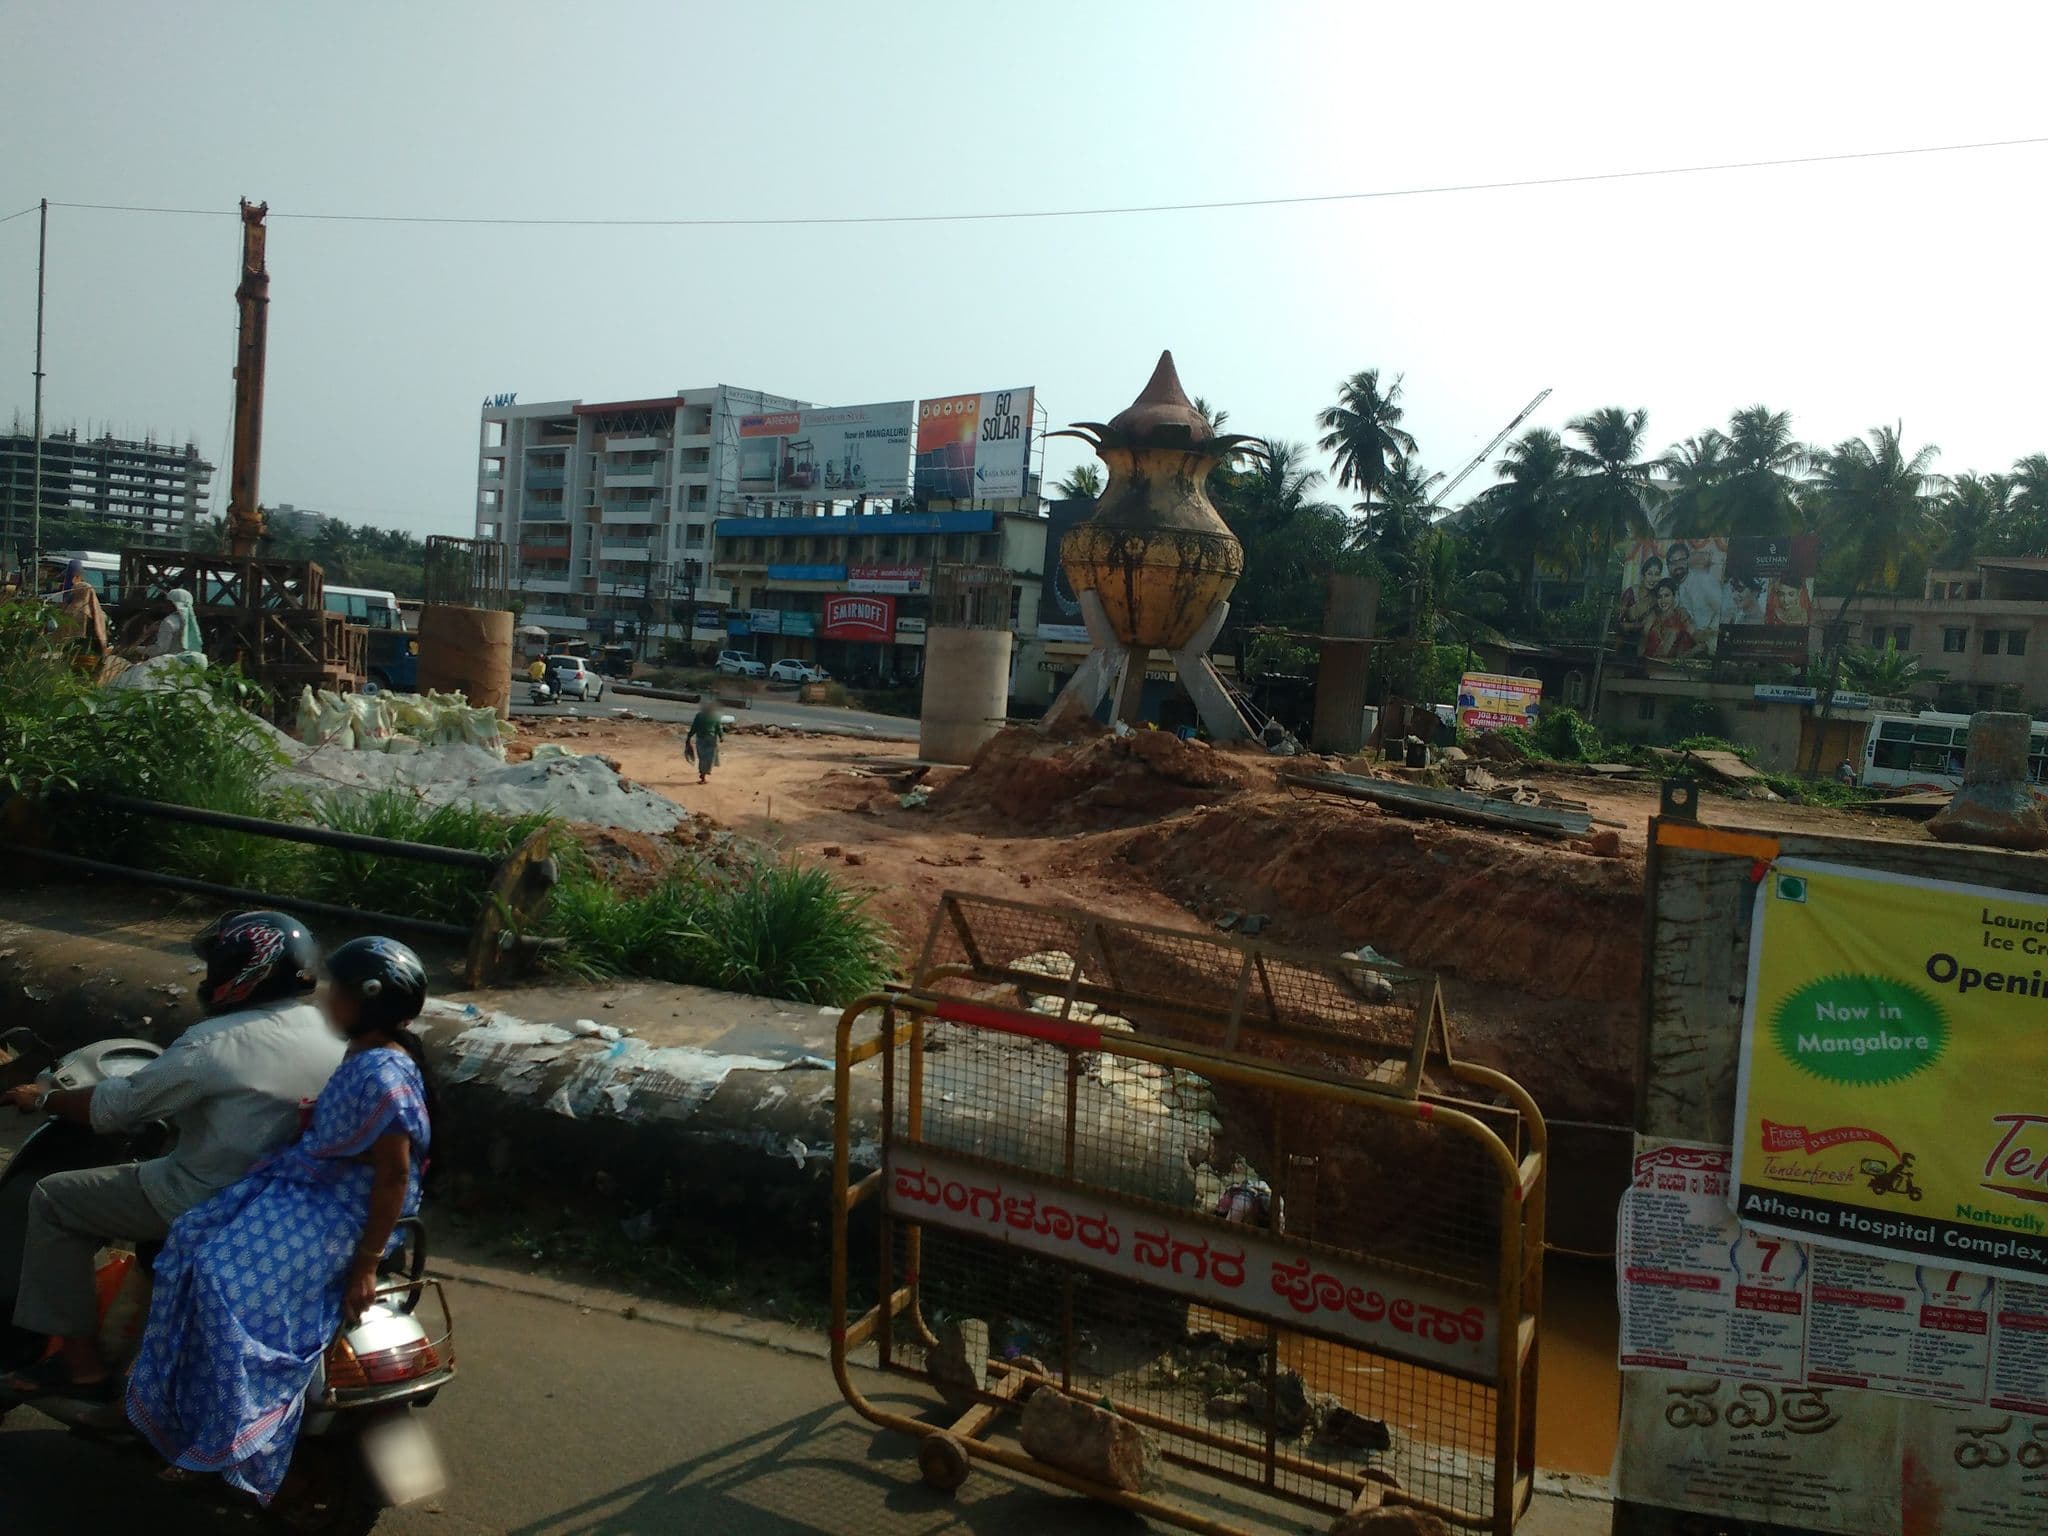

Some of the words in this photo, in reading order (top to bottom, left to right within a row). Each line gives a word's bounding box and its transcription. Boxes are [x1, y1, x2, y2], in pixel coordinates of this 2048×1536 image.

[495, 393, 517, 407] MAK
[995, 392, 1012, 417] GO
[764, 414, 798, 426] ARENA
[982, 415, 1020, 442] SOLAR
[844, 432, 858, 440] Now
[866, 428, 909, 439] MANGALURU
[832, 602, 883, 623] SMIRNOFF
[1982, 908, 2048, 934] Launc
[1984, 931, 2014, 950] Ice
[2023, 937, 2048, 955] Cr
[1815, 1002, 1869, 1021] Now
[1880, 1003, 1902, 1021] in
[1798, 1031, 1929, 1055] Mangalore
[1769, 1127, 1802, 1139] Free
[1771, 1136, 1806, 1147] Home
[1810, 1131, 1871, 1148] DELIVERY
[1763, 1156, 1855, 1184] Tenderfresh
[894, 1166, 1120, 1257] ಮಂಗಳೂರು
[1134, 1225, 1247, 1289] ನಗರ
[1745, 1193, 1831, 1225] Athena
[1839, 1211, 1936, 1243] Hospital
[1943, 1230, 2048, 1265] Complex,
[1956, 1203, 2045, 1234] Naturally
[1756, 1241, 1781, 1273] 7
